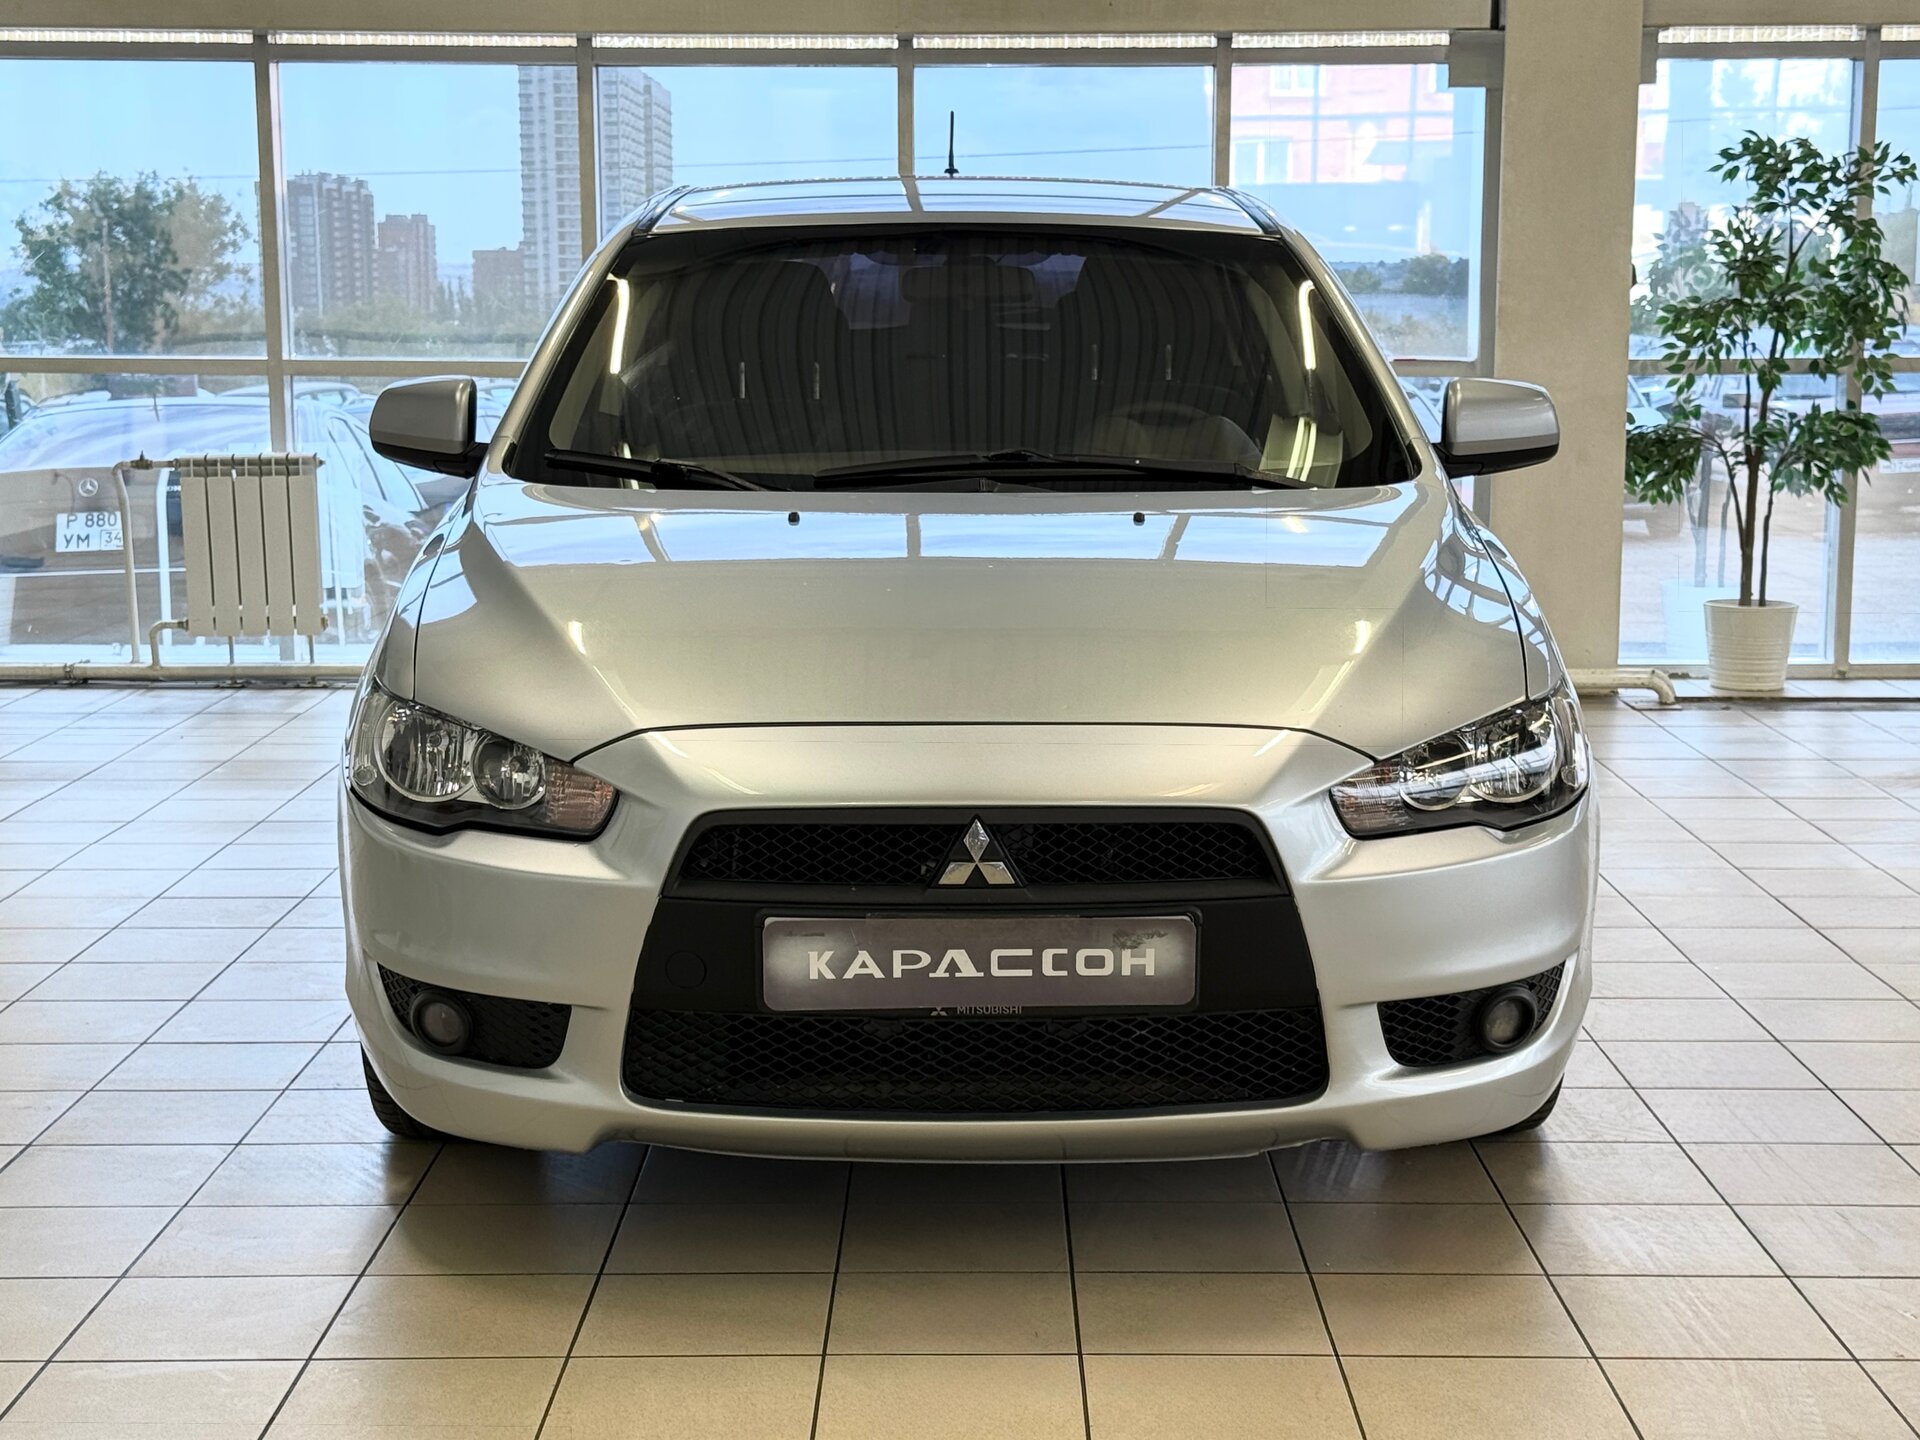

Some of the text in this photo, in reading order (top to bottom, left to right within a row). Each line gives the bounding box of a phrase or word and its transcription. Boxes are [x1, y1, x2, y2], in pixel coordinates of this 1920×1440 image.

[85, 512, 117, 528] 880
[63, 533, 90, 549] УМ
[956, 1004, 1022, 1015] MITSUBISHI
